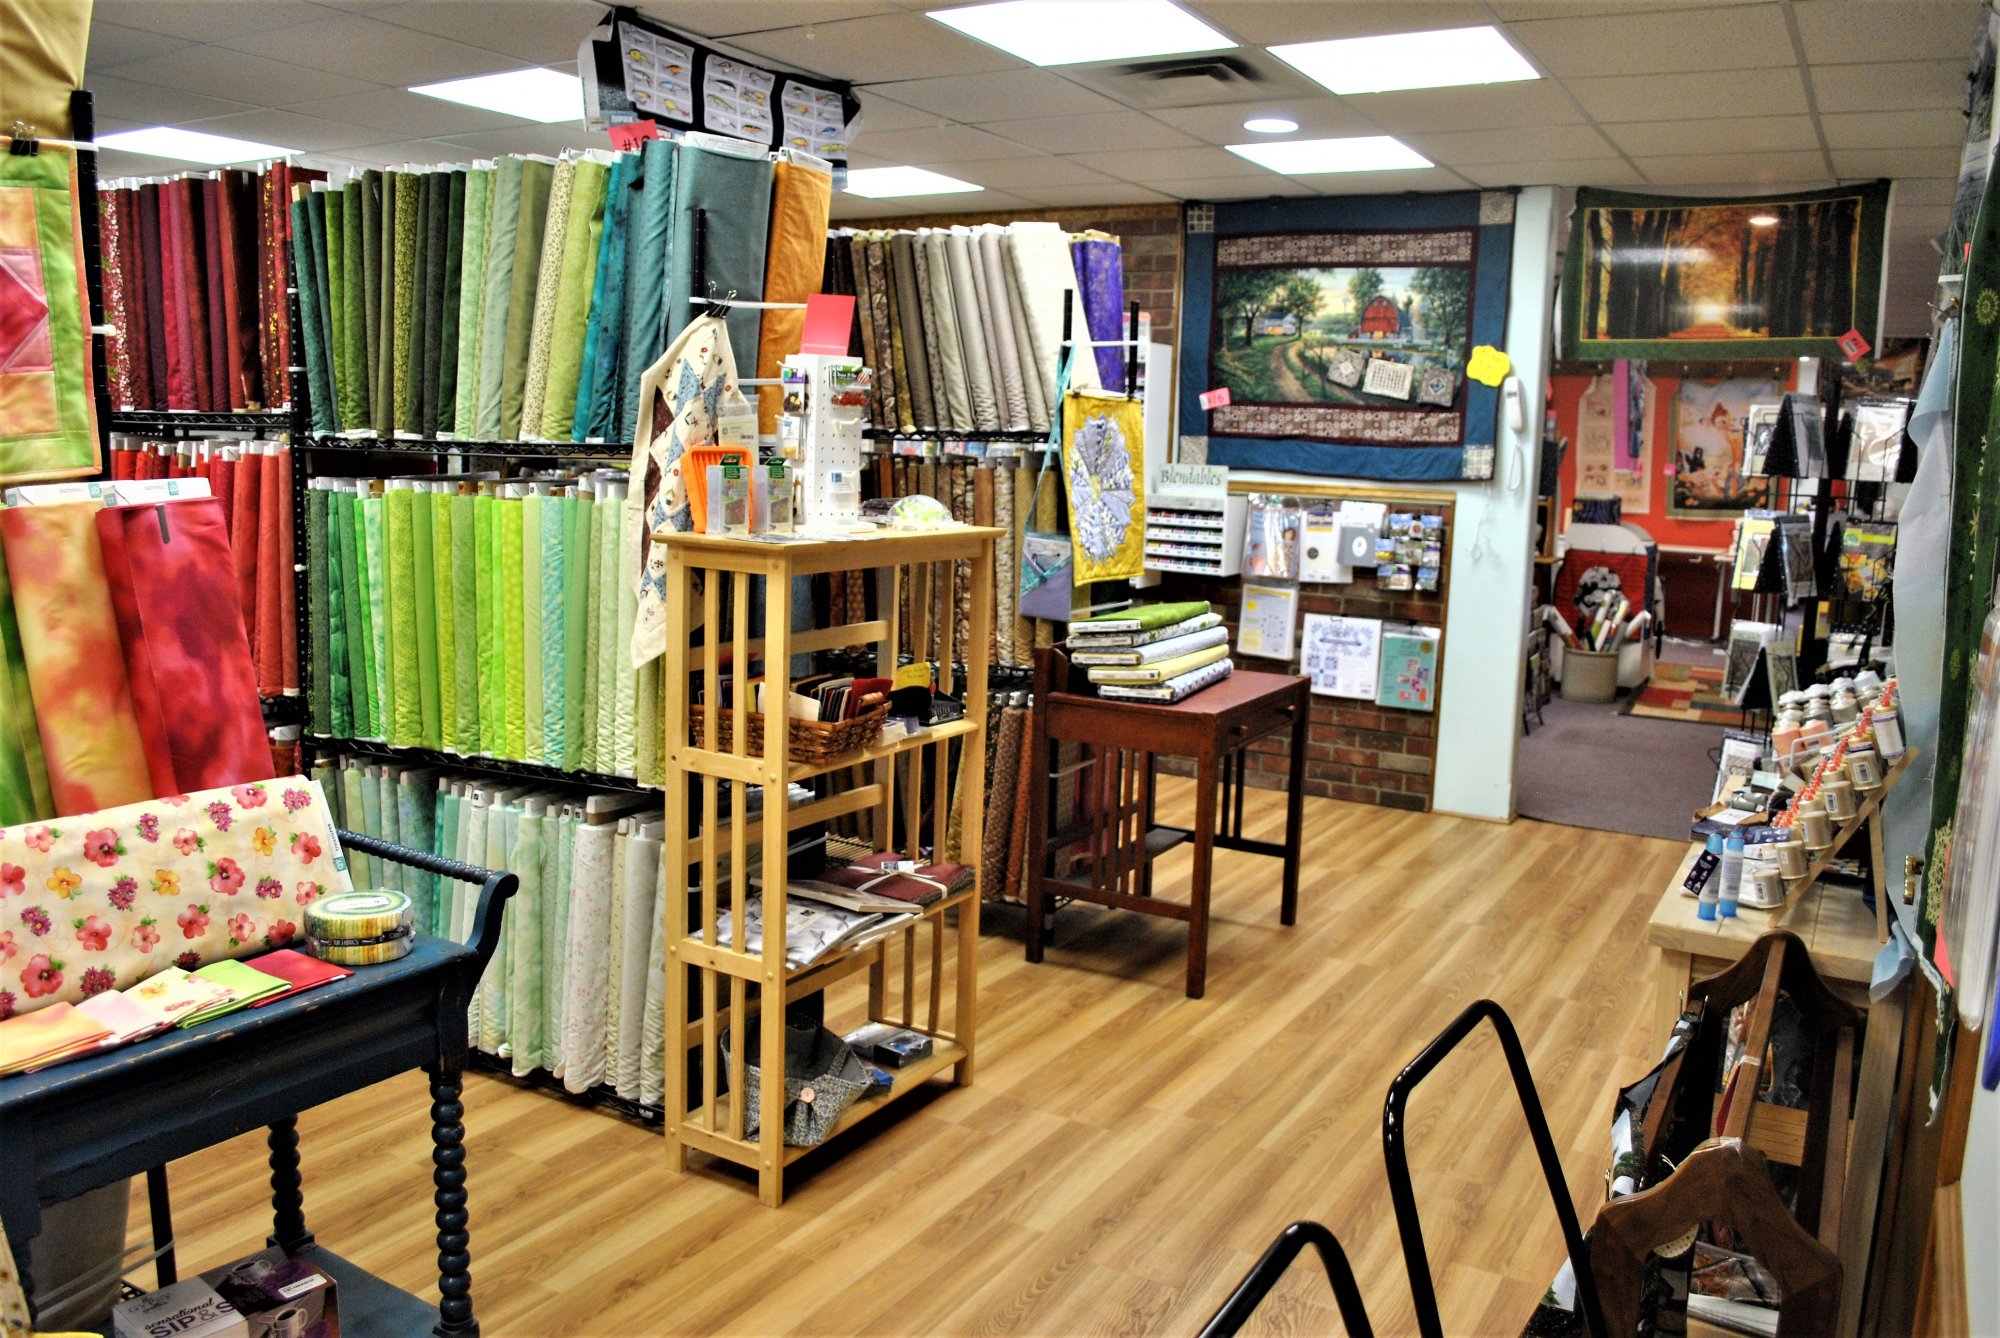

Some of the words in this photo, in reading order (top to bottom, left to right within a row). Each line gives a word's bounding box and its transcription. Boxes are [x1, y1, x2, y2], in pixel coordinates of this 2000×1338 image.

[1160, 465, 1221, 486] Blendables
[328, 823, 339, 851] treasures
[144, 1297, 214, 1330] sensational
[149, 1315, 197, 1338] SIP
[199, 1309, 218, 1321] &
